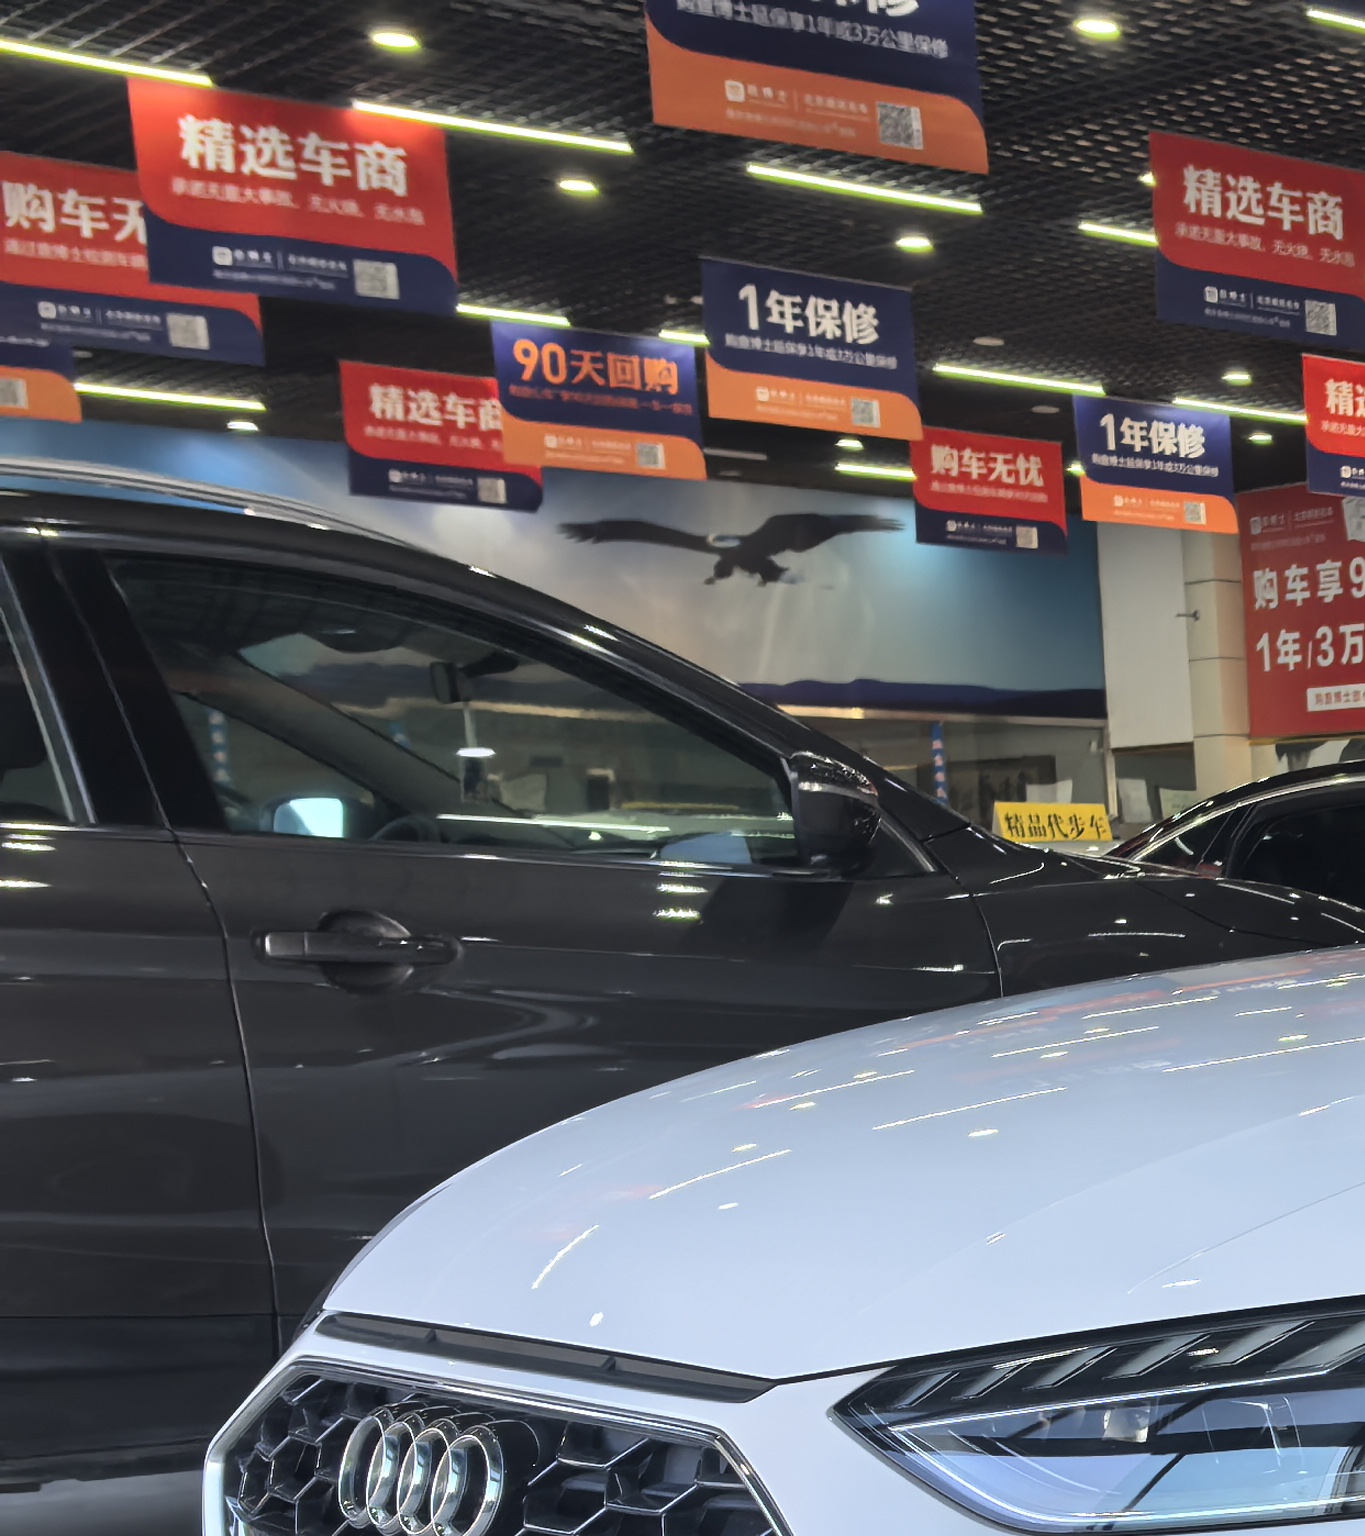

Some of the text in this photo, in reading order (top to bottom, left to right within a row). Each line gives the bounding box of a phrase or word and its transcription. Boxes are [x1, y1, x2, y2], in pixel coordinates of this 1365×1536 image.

[178, 114, 408, 197] 精选车商
[1183, 163, 1344, 241] 精选车商
[739, 283, 880, 345] 1年保修
[512, 339, 679, 395] 90天回购
[1101, 412, 1206, 459] 1年保修
[930, 443, 1045, 488] 购车无忧
[1004, 812, 1107, 841] 精品代步车
